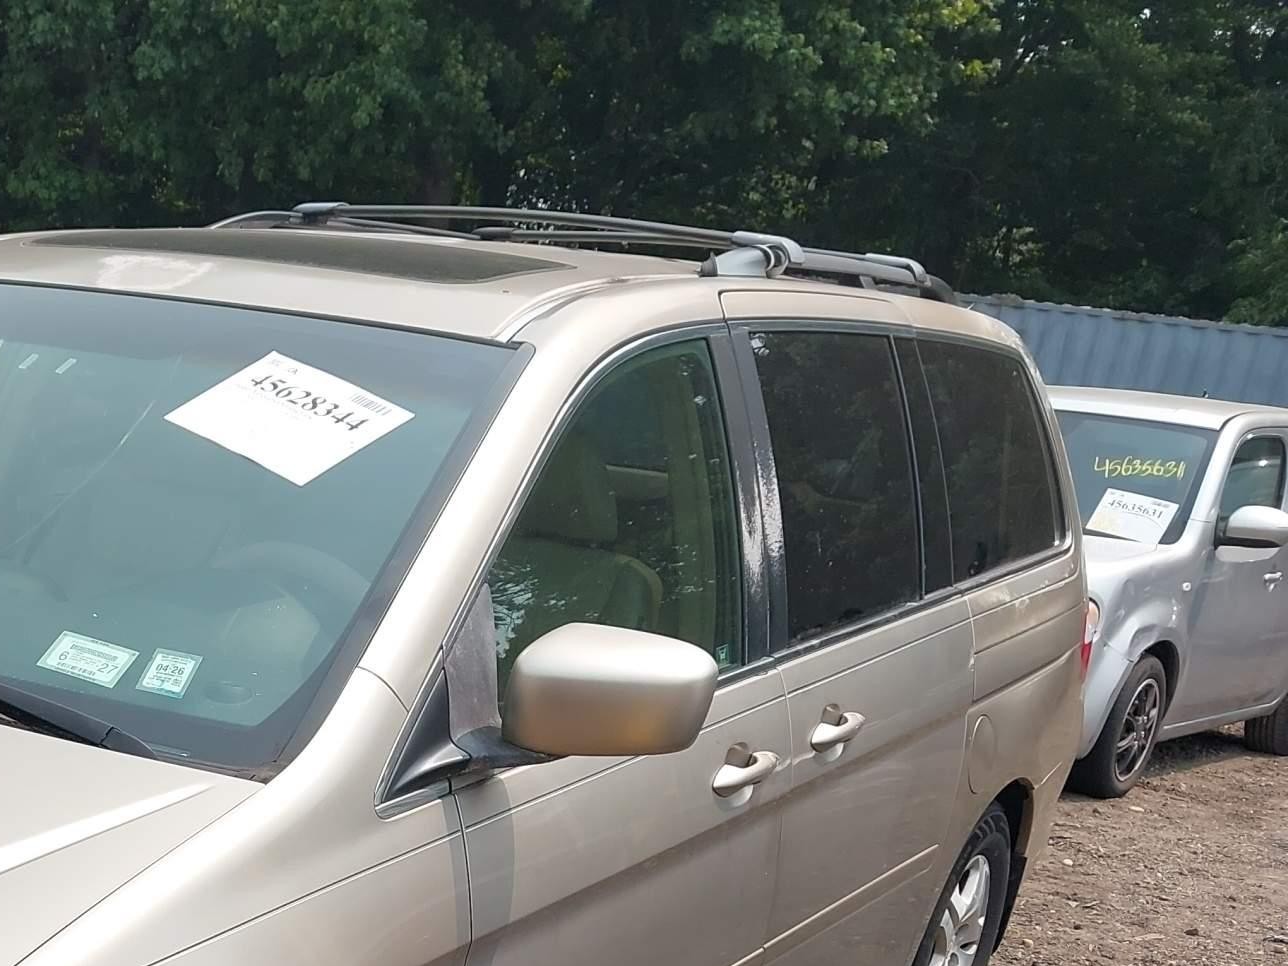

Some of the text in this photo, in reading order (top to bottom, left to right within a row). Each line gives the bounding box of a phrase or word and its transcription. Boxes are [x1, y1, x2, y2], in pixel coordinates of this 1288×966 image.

[250, 375, 369, 431] 45628344
[1108, 499, 1163, 519] 45635631
[58, 650, 70, 661] 6
[96, 662, 119, 675] 27
